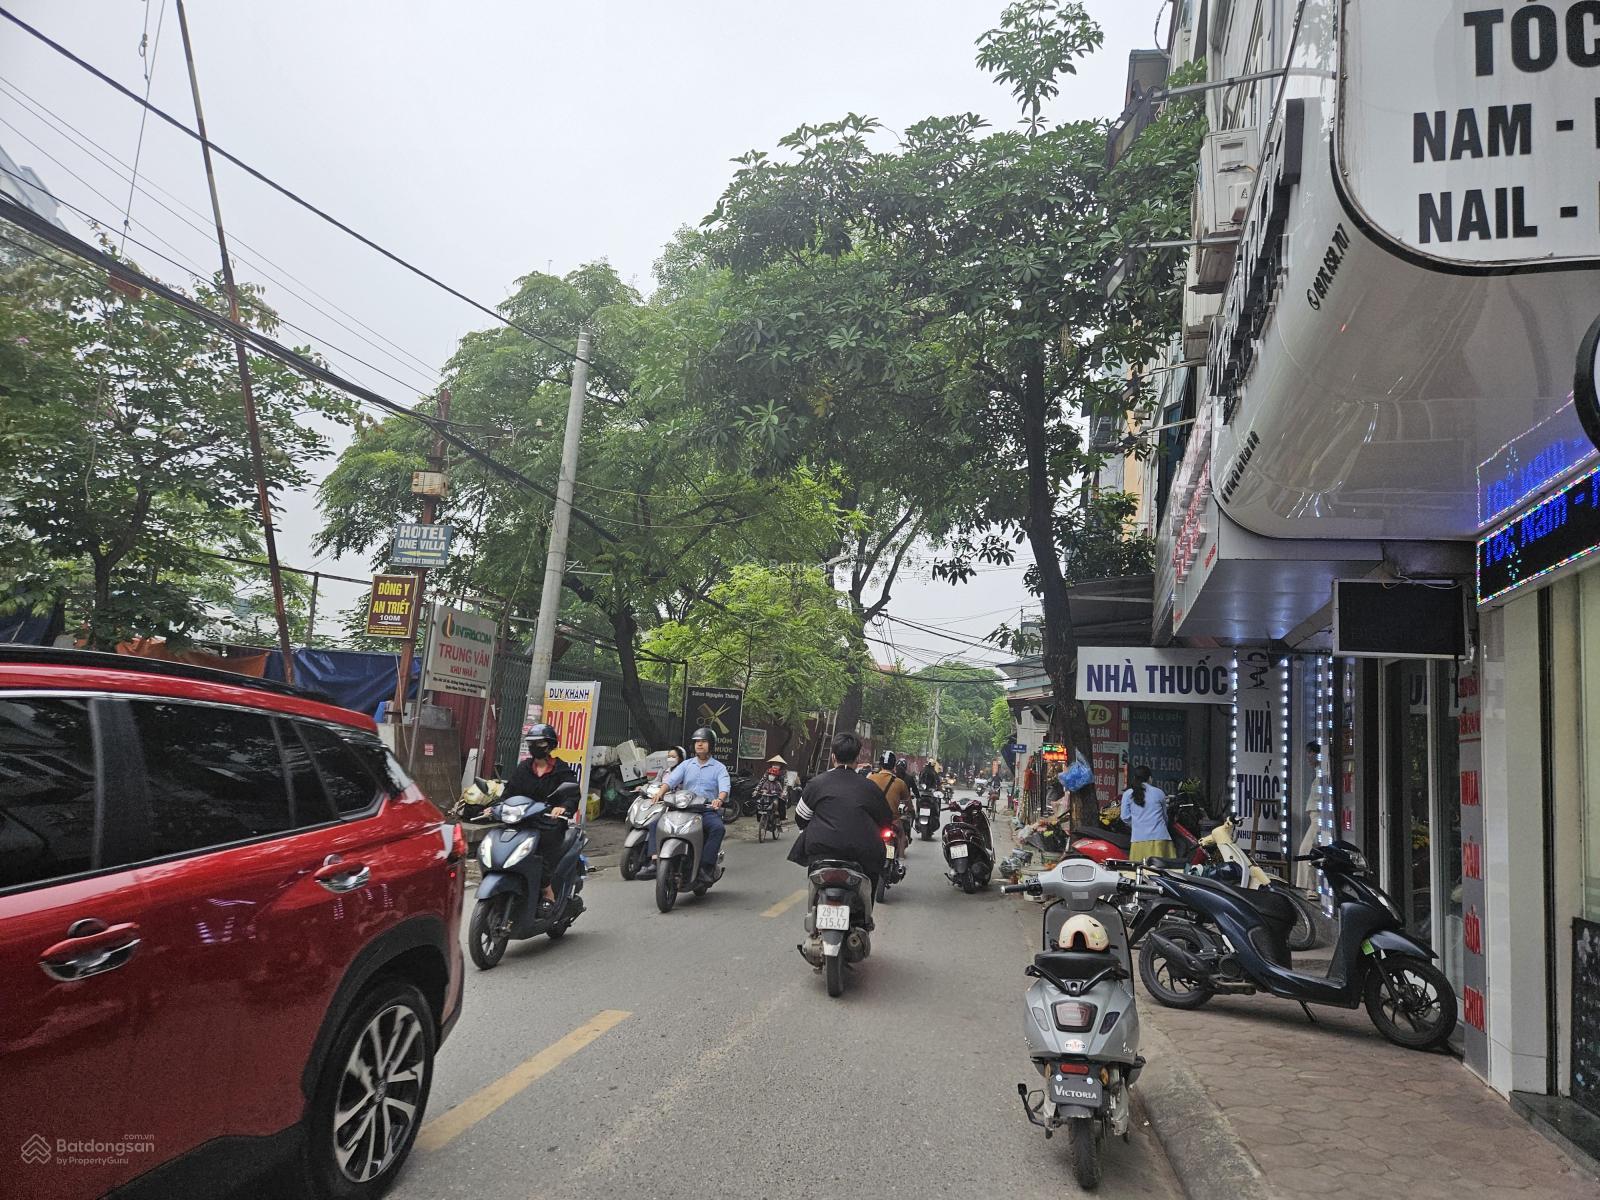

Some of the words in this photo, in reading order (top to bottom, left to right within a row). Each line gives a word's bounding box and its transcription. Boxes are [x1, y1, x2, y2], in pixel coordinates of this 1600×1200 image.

[1413, 103, 1532, 163] NAM
[1418, 186, 1538, 244] NAIL
[400, 525, 447, 540] HOTEL
[397, 539, 417, 549] ONE
[420, 540, 446, 550] VILLA
[377, 580, 402, 596] ĐÔNG
[372, 600, 385, 614] AN
[438, 643, 472, 663] TRUNG
[1086, 658, 1138, 693] NHÀ
[1145, 655, 1229, 696] THUỐC
[550, 688, 565, 699] DUY
[565, 685, 590, 699] KHÁNH
[1090, 709, 1108, 721] 79
[565, 708, 588, 751] HƠI
[1245, 700, 1273, 754] NHÀ
